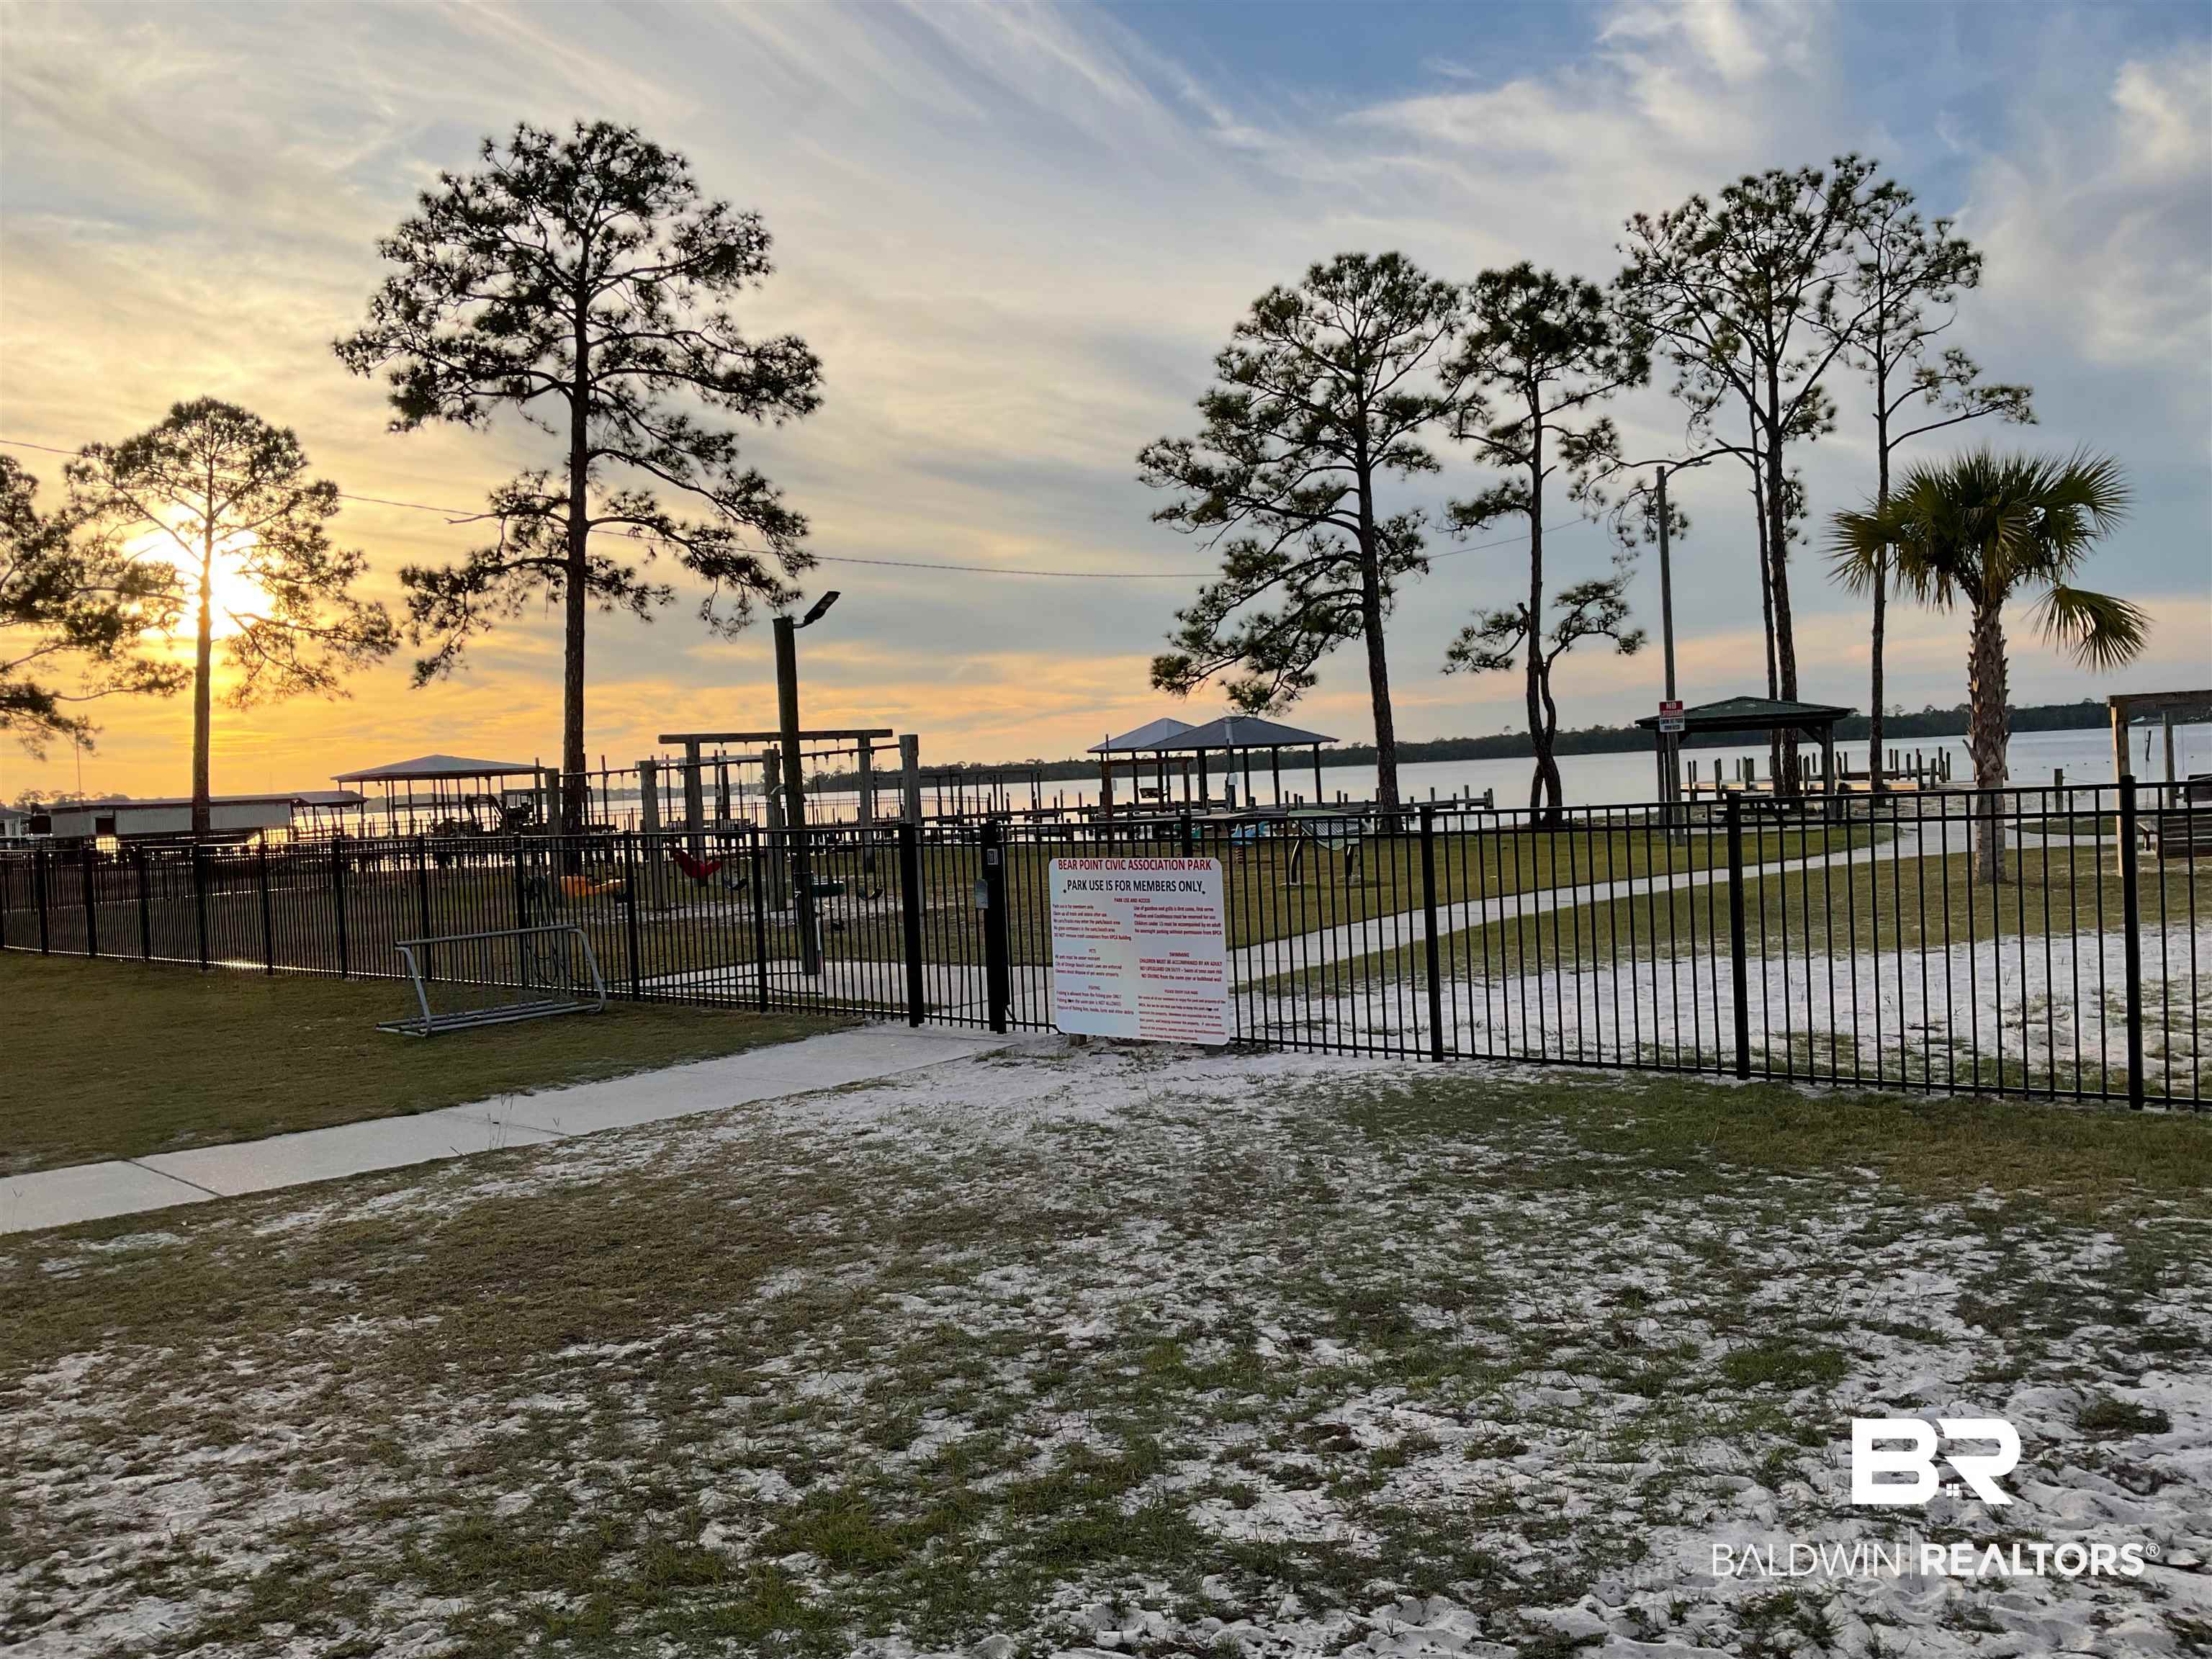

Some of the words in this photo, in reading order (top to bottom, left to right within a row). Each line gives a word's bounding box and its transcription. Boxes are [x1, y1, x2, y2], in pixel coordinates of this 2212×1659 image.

[1058, 859, 1077, 870] BEAR
[1079, 859, 1103, 870] POINT
[1105, 860, 1126, 871] CIVIC
[1128, 859, 1184, 871] ASSOCIATION
[1187, 859, 1212, 871] PARK
[1067, 880, 1087, 891] PARK
[1089, 880, 1104, 891] USE
[1105, 880, 1113, 891] IS
[1115, 880, 1131, 891] FOR
[1133, 881, 1177, 891] MEMBERS
[1178, 881, 1202, 892] ONLY
